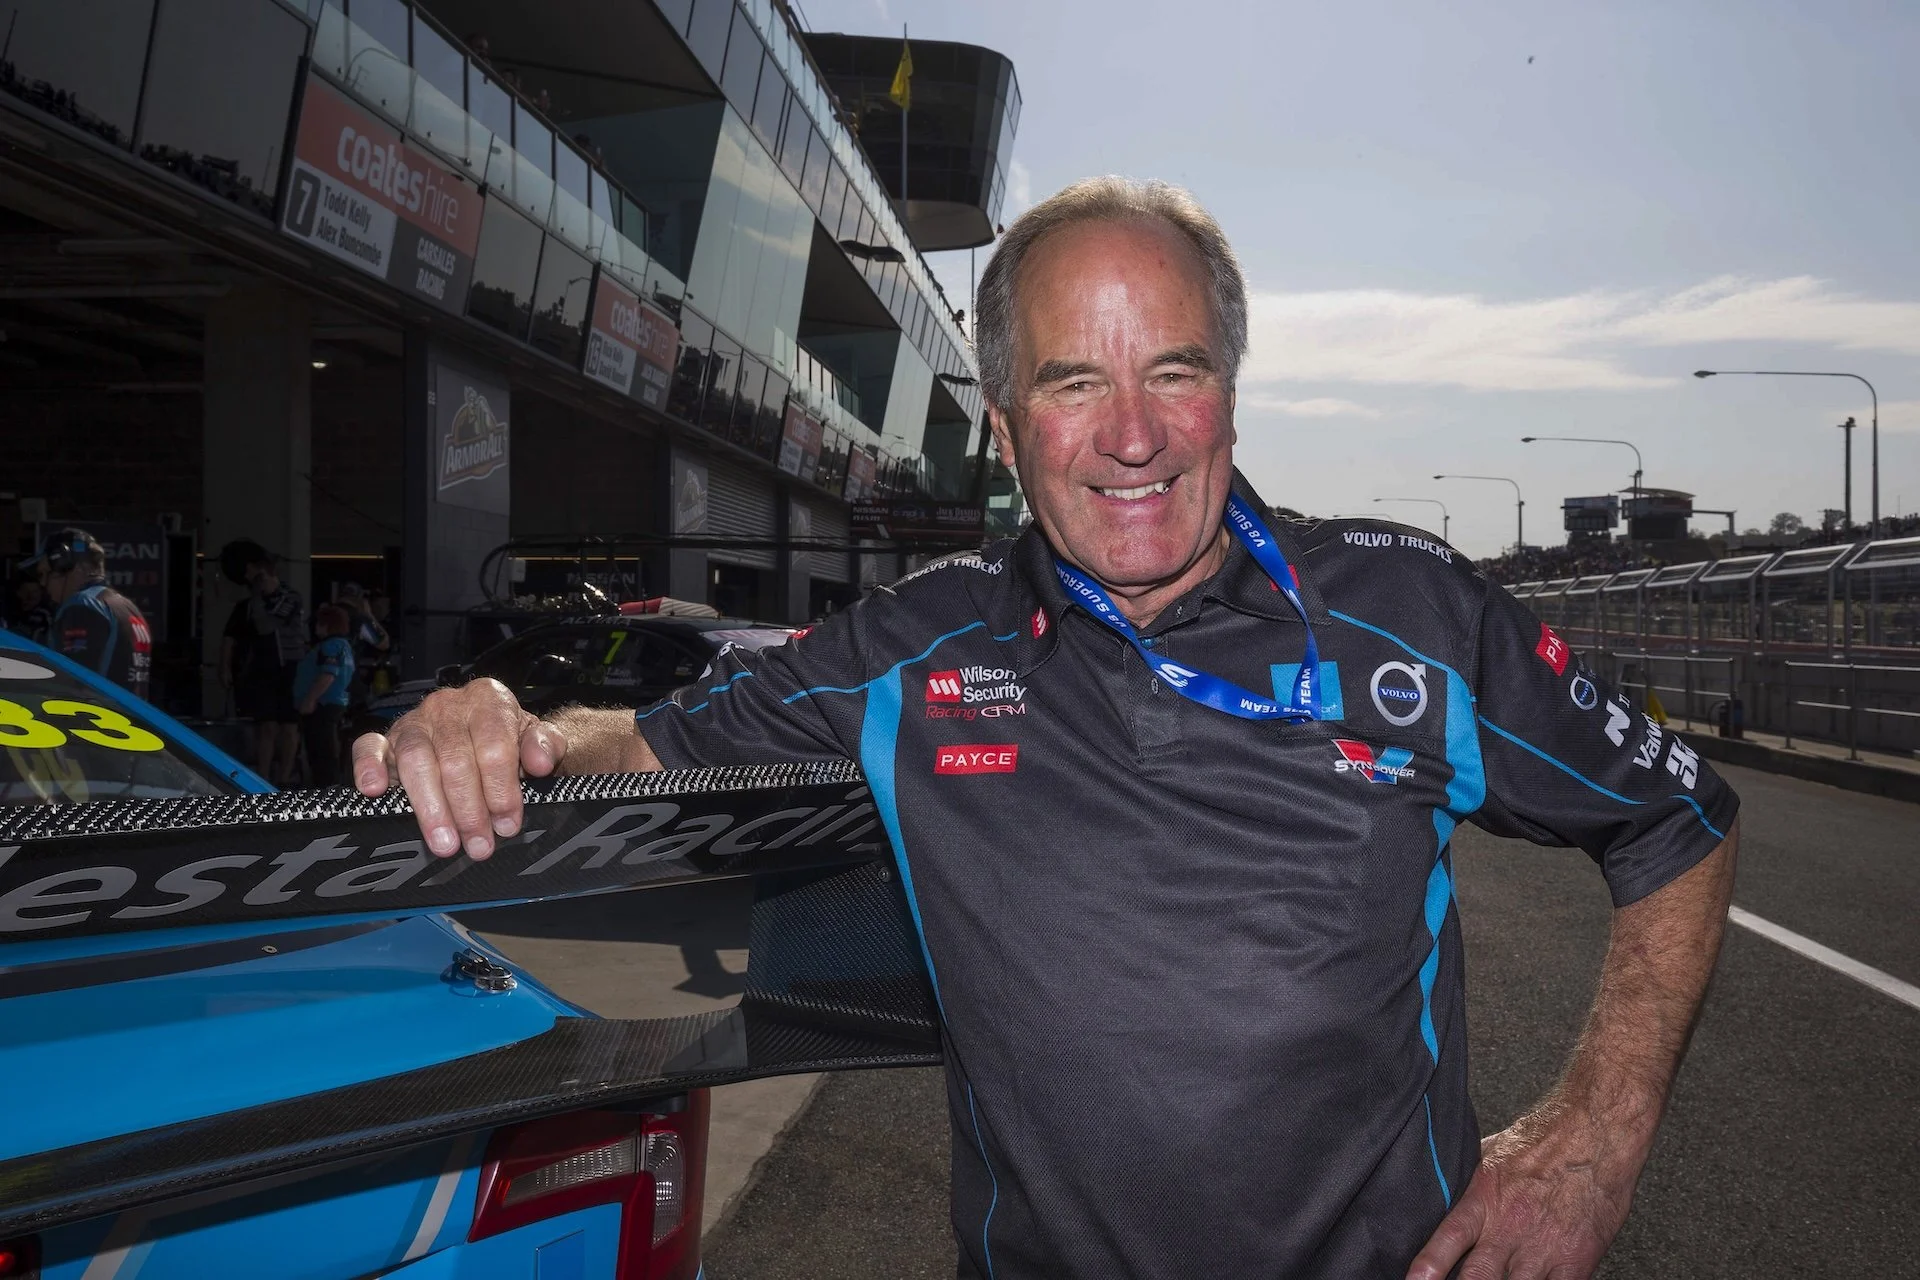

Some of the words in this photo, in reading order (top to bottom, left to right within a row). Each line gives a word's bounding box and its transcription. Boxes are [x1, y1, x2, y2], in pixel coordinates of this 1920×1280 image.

[337, 126, 425, 213] coates
[421, 168, 459, 234] hire
[298, 179, 314, 225] 7
[324, 185, 349, 218] Todd
[348, 198, 372, 234] Kelly
[315, 216, 338, 243] Alex
[415, 268, 446, 300] RACING
[1248, 529, 1266, 548] V8
[1343, 531, 1393, 547] VOLVO
[1397, 534, 1453, 565] TRUCKS
[104, 542, 160, 560] SAN
[906, 560, 949, 581] VOLVO
[601, 631, 629, 665] 7
[959, 665, 1017, 685] Wilson
[1300, 667, 1312, 705] TEAM
[963, 682, 1027, 704] Security
[1381, 688, 1418, 700] VOLVO
[925, 705, 977, 721] Racing
[1239, 698, 1278, 713] TEAM
[940, 752, 1013, 767] PAYCE
[517, 786, 881, 877] Racin
